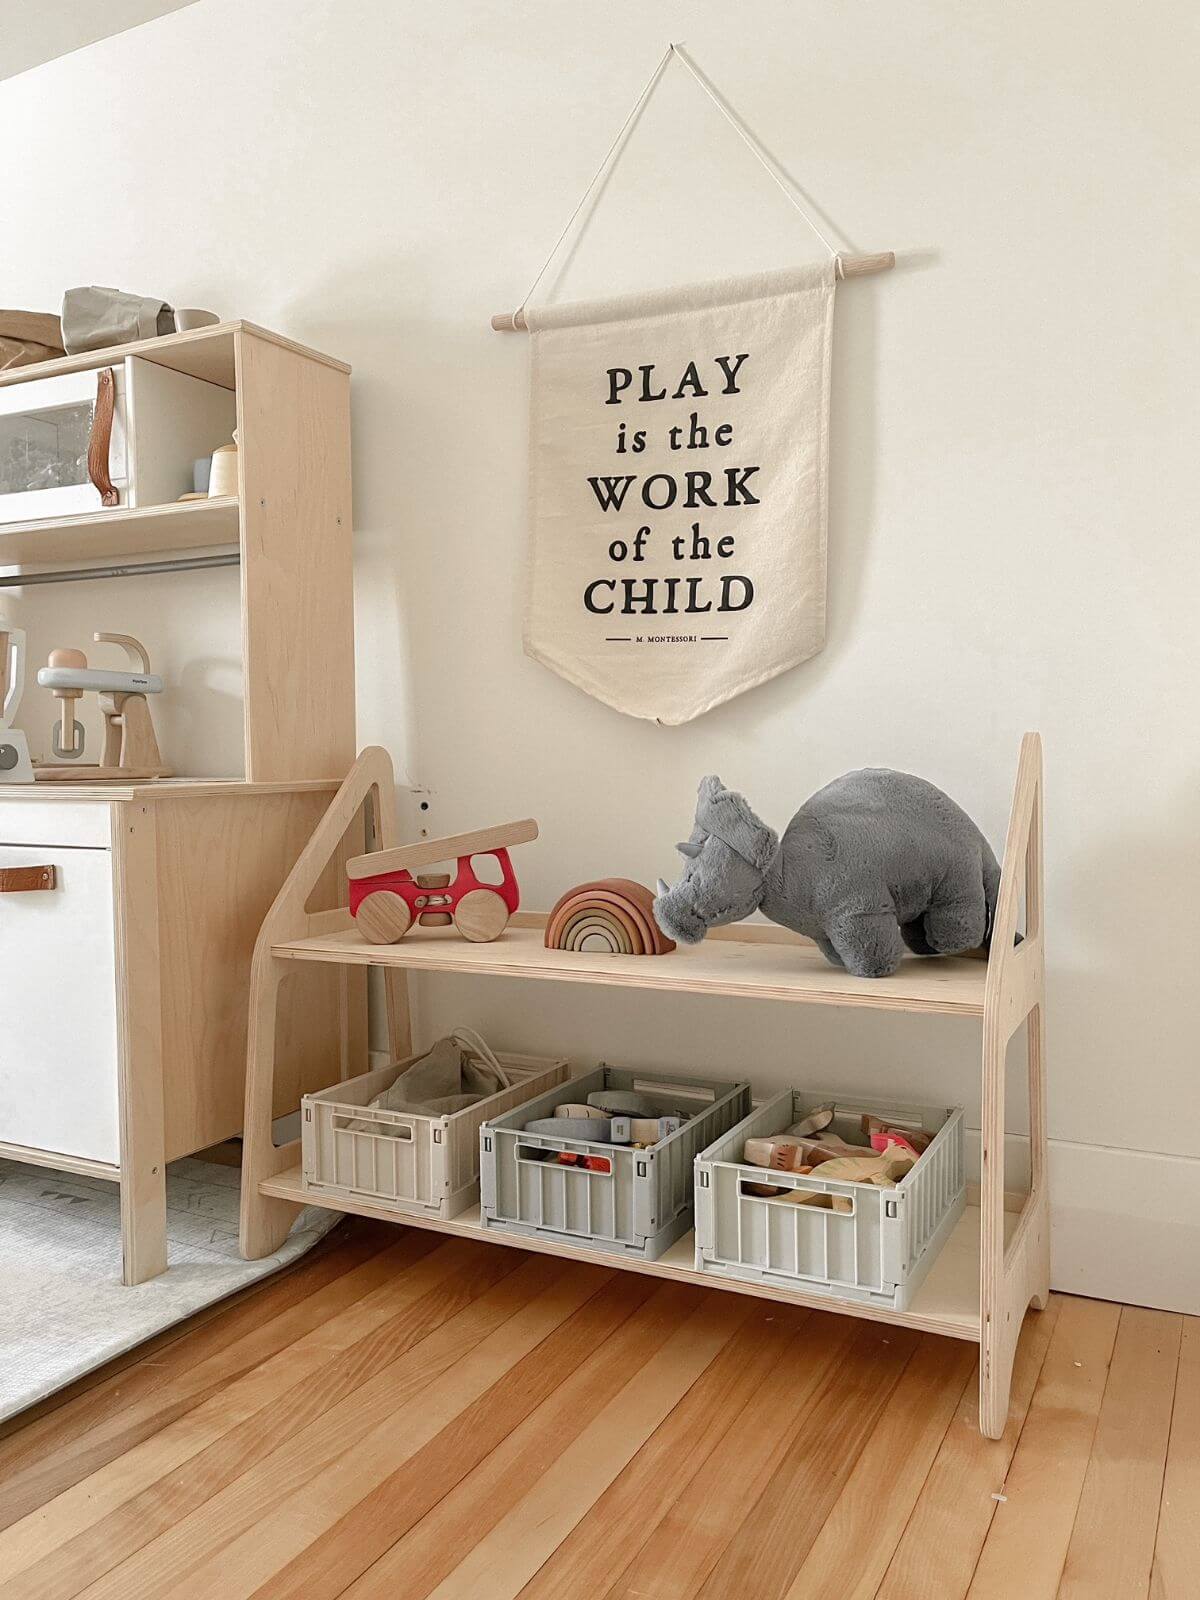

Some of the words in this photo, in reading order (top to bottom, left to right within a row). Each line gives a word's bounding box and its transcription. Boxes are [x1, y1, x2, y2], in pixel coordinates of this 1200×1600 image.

[605, 354, 750, 405] PLAY
[616, 423, 647, 454] is
[669, 412, 734, 451] the
[587, 467, 761, 513] WORK
[609, 526, 652, 562] of
[672, 523, 736, 561] the
[584, 576, 755, 615] CHILD
[647, 635, 698, 643] MONTESSORI
